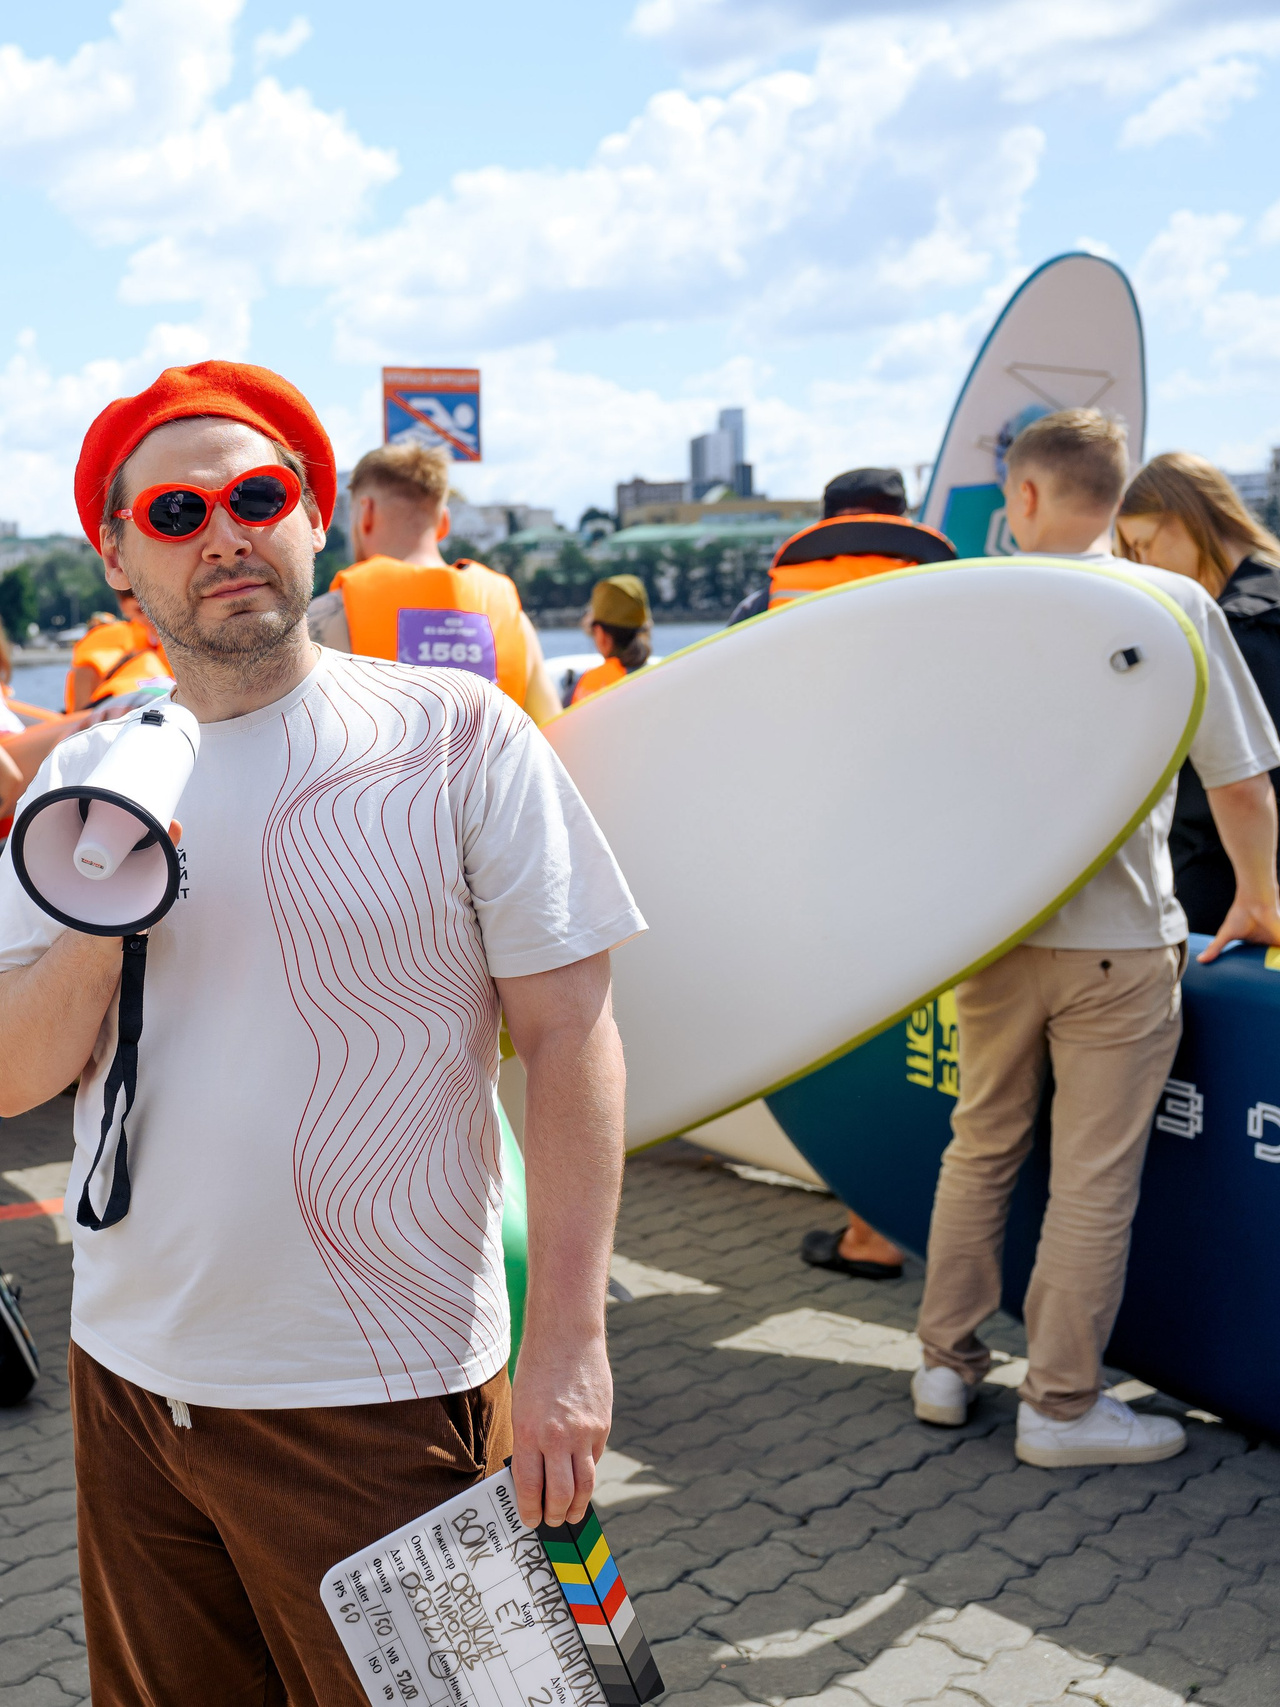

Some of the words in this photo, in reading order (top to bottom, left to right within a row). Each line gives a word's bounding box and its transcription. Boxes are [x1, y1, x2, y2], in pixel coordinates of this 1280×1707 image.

[417, 641, 483, 664] 1563
[495, 1484, 522, 1534] ФИЛЬМ
[432, 1524, 456, 1571] Режиссер
[451, 1508, 494, 1571] ВОЛК
[485, 1521, 503, 1554] Сцена
[389, 1549, 406, 1572] Дата
[410, 1535, 436, 1583] Оператор
[332, 1579, 348, 1598] FPS
[350, 1569, 370, 1603] Shutter
[373, 1558, 393, 1594] Фильтр
[504, 1530, 570, 1634] КРАСНАЯ
[339, 1603, 361, 1624] 60
[365, 1603, 393, 1637] 1/50
[400, 1571, 454, 1644] 05.07.25
[450, 1572, 508, 1663] ОРЕШКИН
[494, 1599, 526, 1635] E1
[520, 1601, 536, 1628] Кадр
[433, 1581, 482, 1671] ПИРОГОВ
[368, 1655, 383, 1674] ISO
[385, 1646, 400, 1665] WB
[437, 1653, 452, 1676] День
[396, 1669, 419, 1700] 5200
[449, 1676, 462, 1706] Ночь
[528, 1686, 553, 1707] 2
[550, 1676, 567, 1704] Дубль
